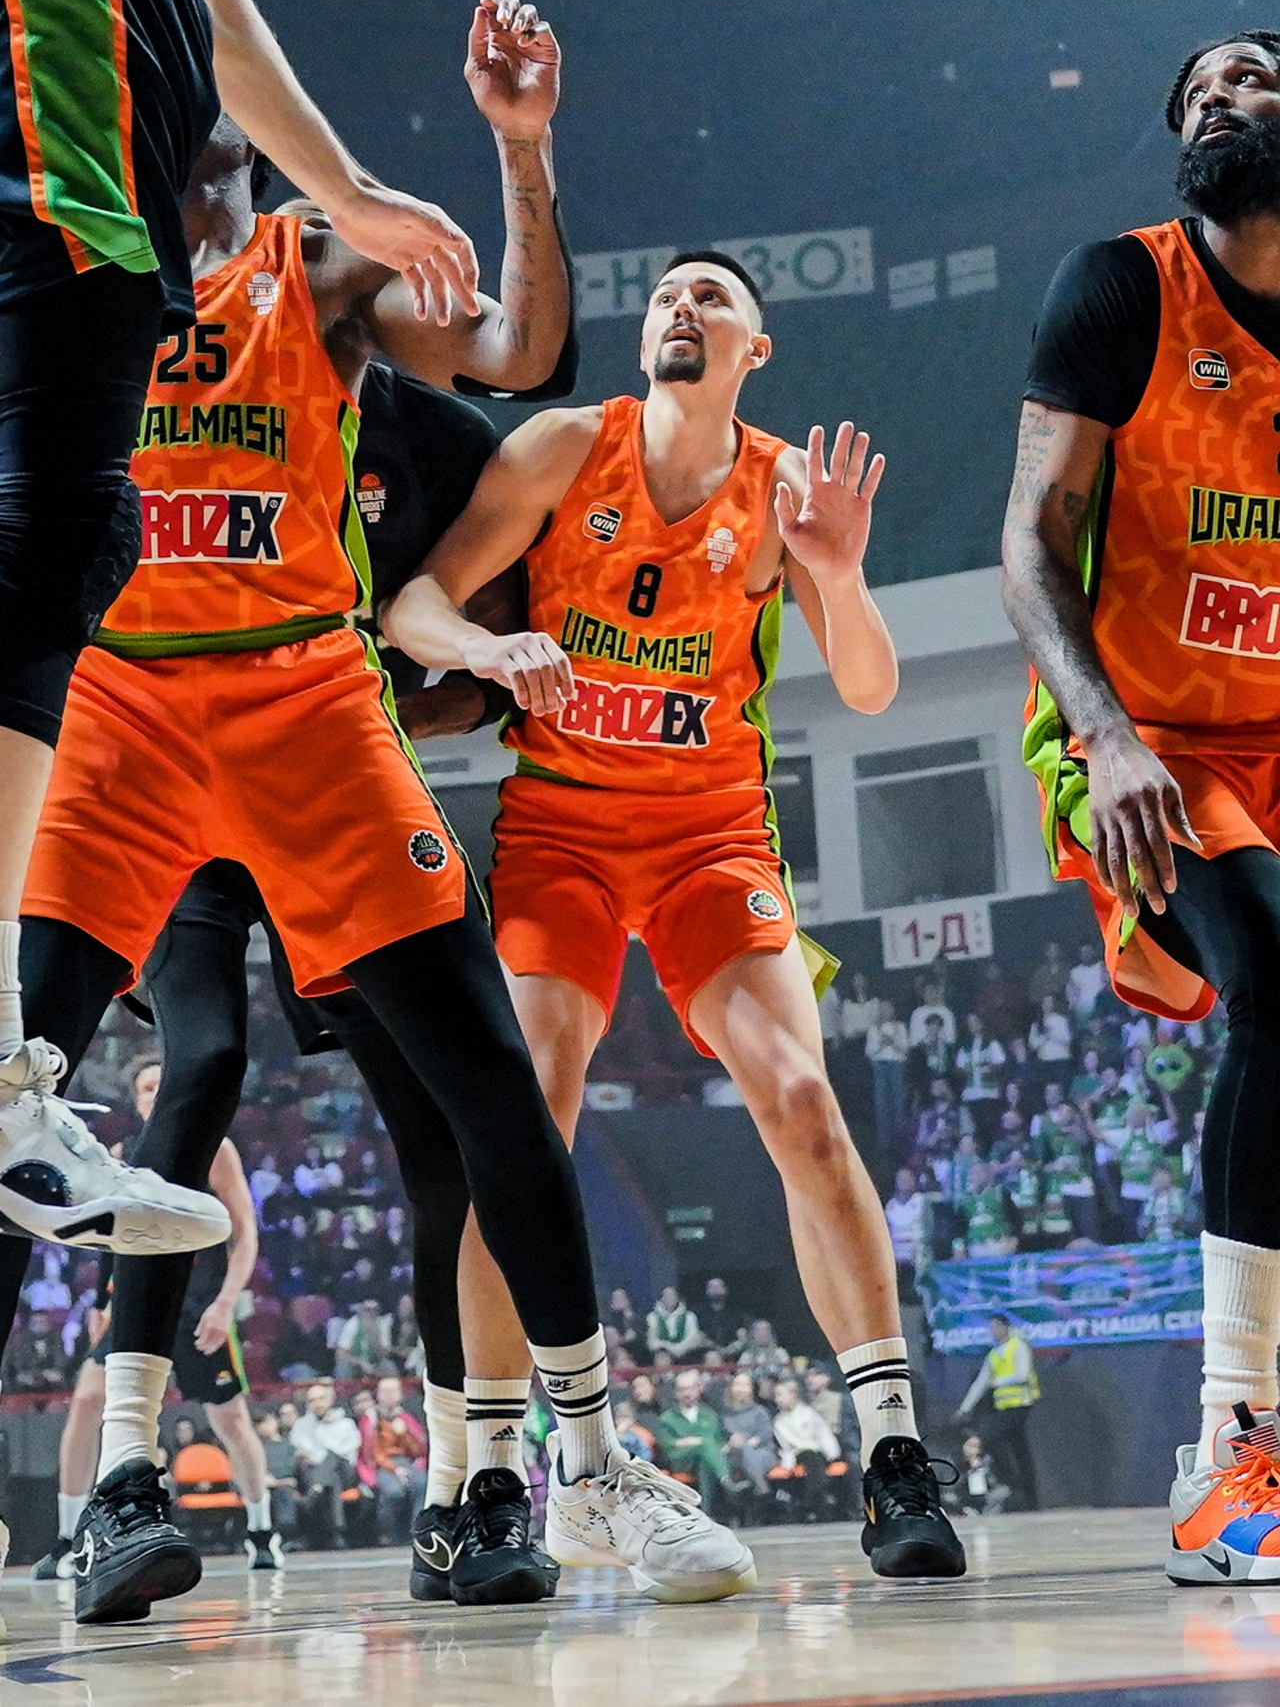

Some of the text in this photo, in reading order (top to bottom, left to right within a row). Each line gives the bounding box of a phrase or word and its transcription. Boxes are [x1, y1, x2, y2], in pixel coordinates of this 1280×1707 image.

[156, 323, 229, 385] 25
[1199, 362, 1227, 377] WIN
[132, 402, 288, 468] ALMASH
[140, 493, 284, 561] ROZEX
[592, 515, 619, 533] WIN
[627, 562, 663, 619] 8
[560, 605, 715, 679] URALMASH
[561, 679, 714, 746] BROZEX
[901, 913, 969, 958] 1-Д
